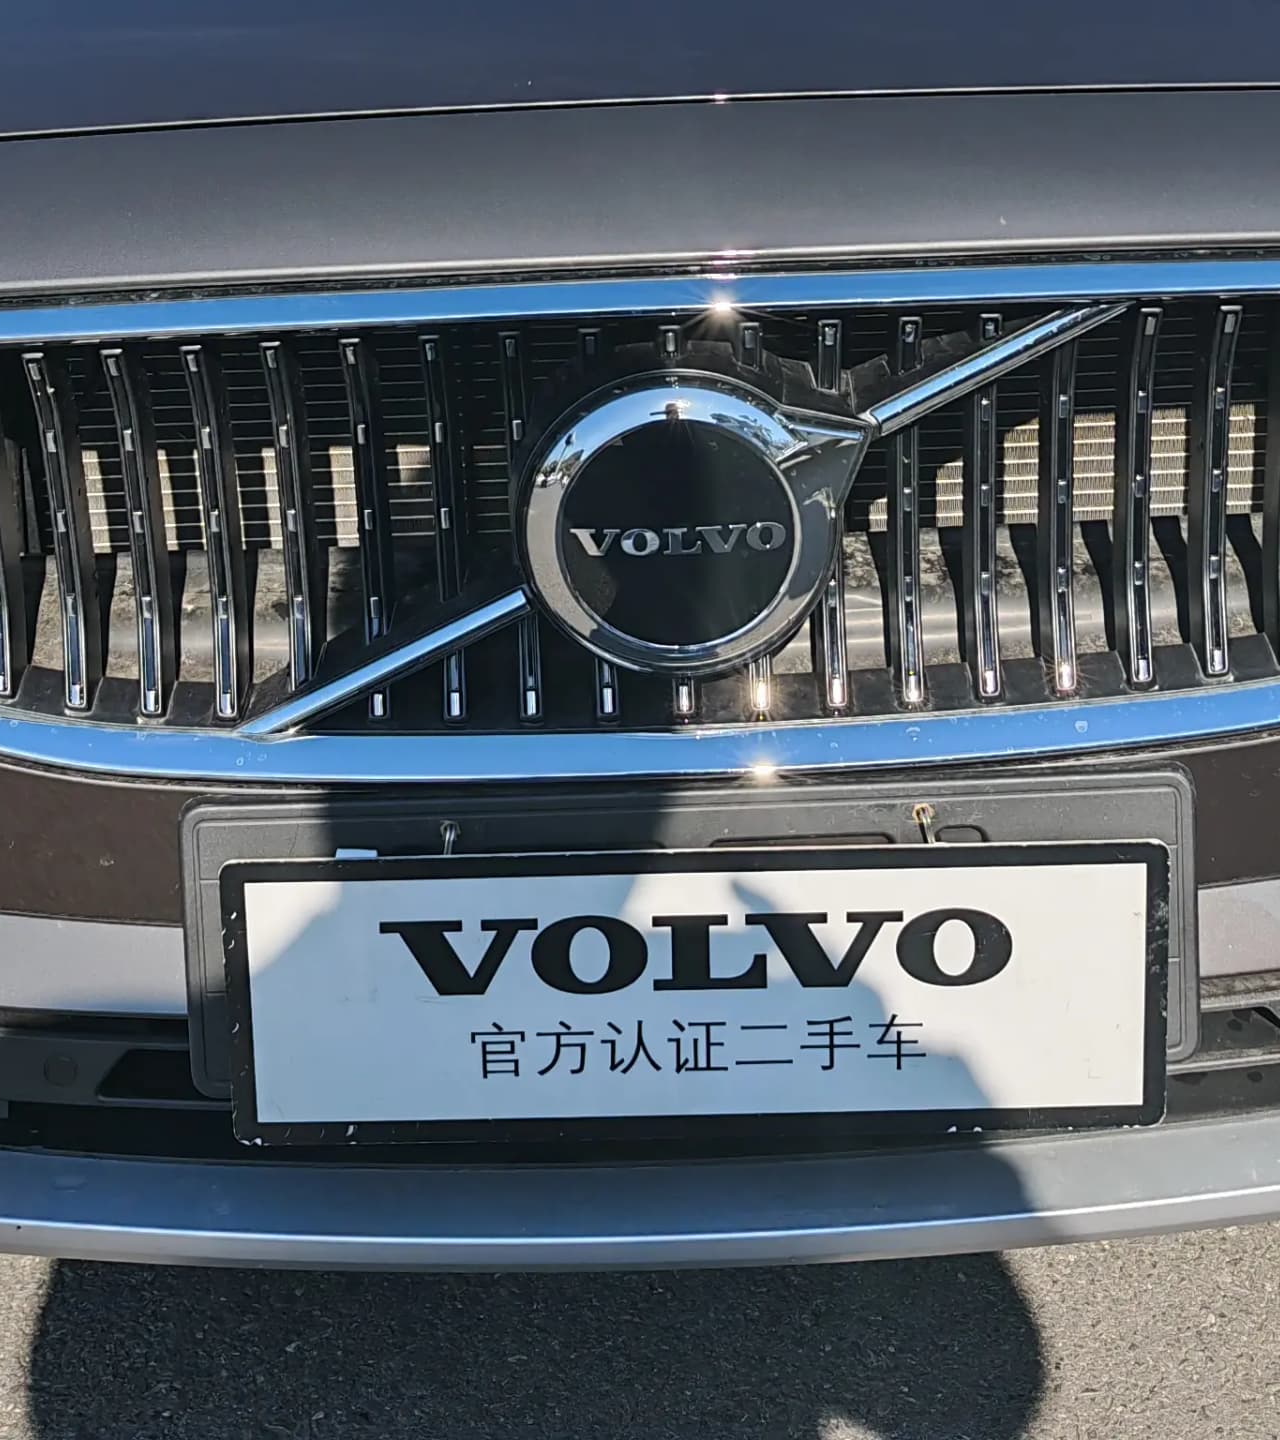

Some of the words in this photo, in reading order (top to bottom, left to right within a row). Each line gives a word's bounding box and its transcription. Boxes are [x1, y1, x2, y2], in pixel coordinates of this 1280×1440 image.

[570, 521, 787, 557] VOLVO
[379, 908, 1012, 996] VOLVO
[471, 1014, 926, 1079] 官方认证二手车
